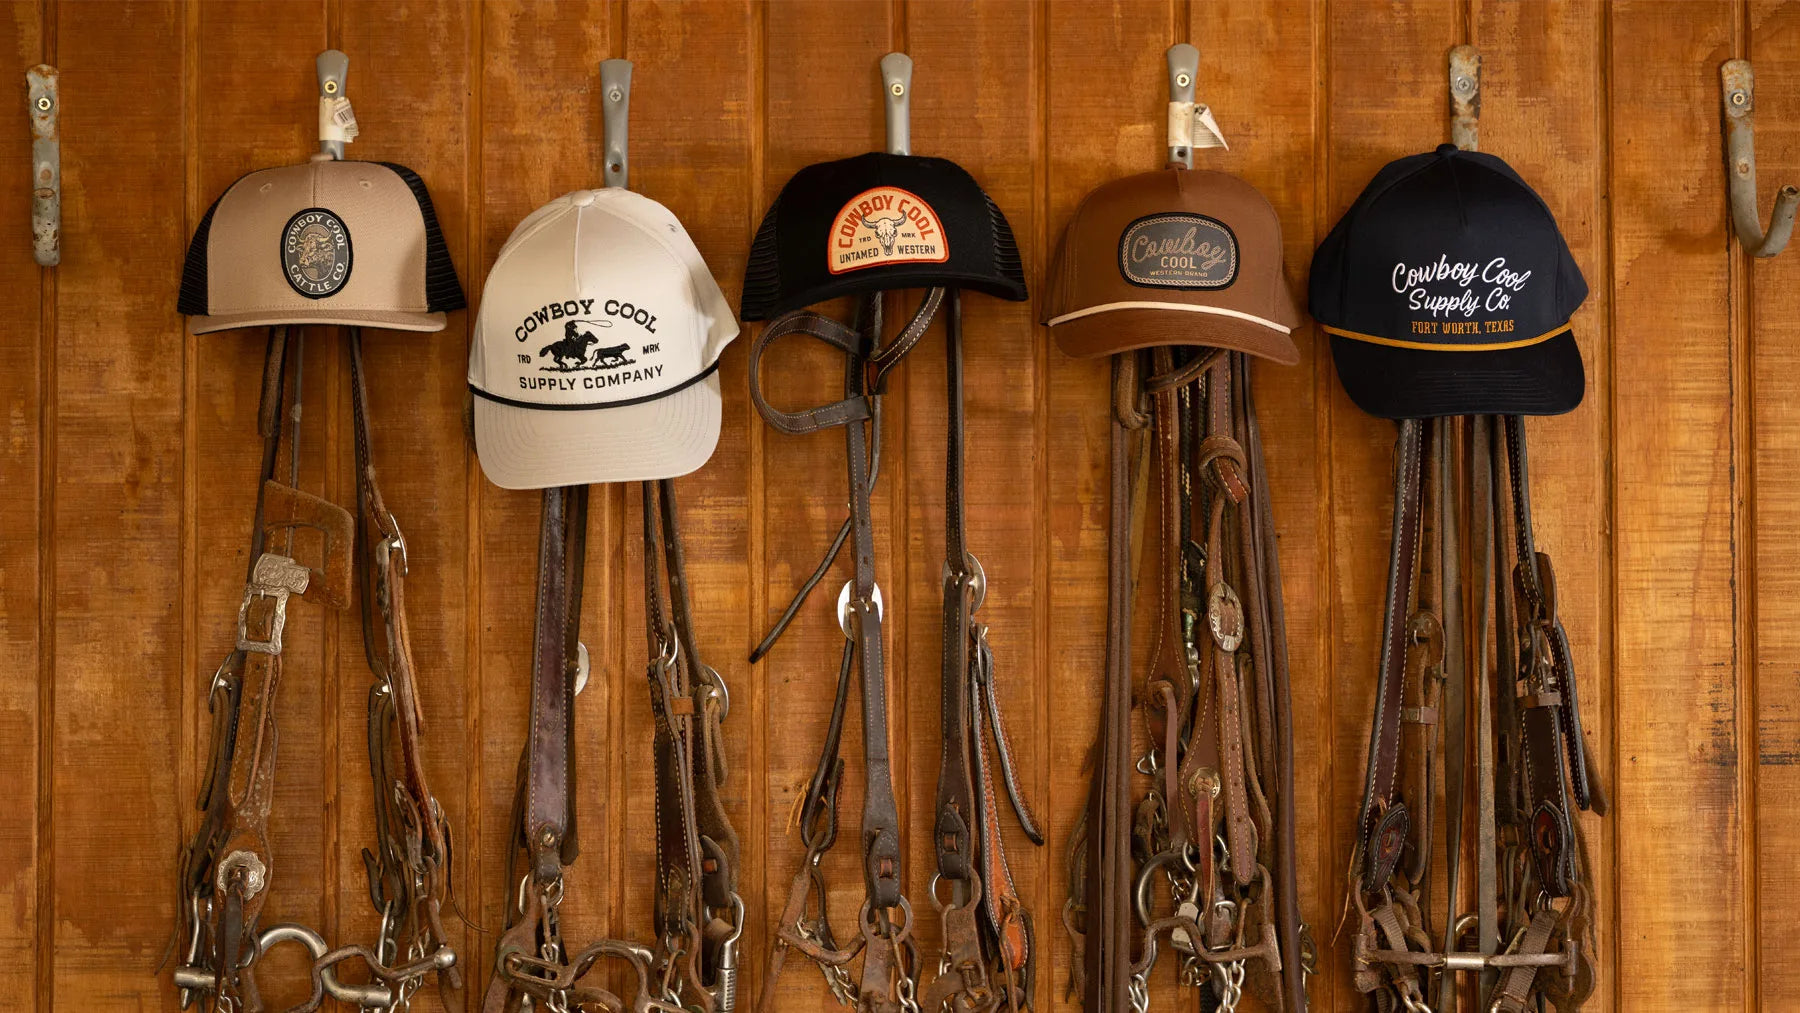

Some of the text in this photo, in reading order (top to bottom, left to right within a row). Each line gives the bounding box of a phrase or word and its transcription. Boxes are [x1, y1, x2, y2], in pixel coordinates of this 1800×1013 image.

[287, 214, 345, 253] COWBOY COOL
[838, 194, 935, 248] COWBOY COOL
[839, 245, 936, 264] UNTAMED WESTERN
[1131, 226, 1227, 271] Cowboy
[1160, 256, 1197, 269] COOL
[290, 264, 332, 292] CATTLE
[1391, 253, 1532, 293] Cowboy Cool
[1408, 287, 1512, 318] Supply Co.
[514, 299, 657, 343] COWBOY COOL
[1411, 319, 1515, 335] FORT WORTH, TEXAS
[517, 342, 661, 365] TRD MRK
[519, 364, 664, 391] SUPPLY COMPANY
